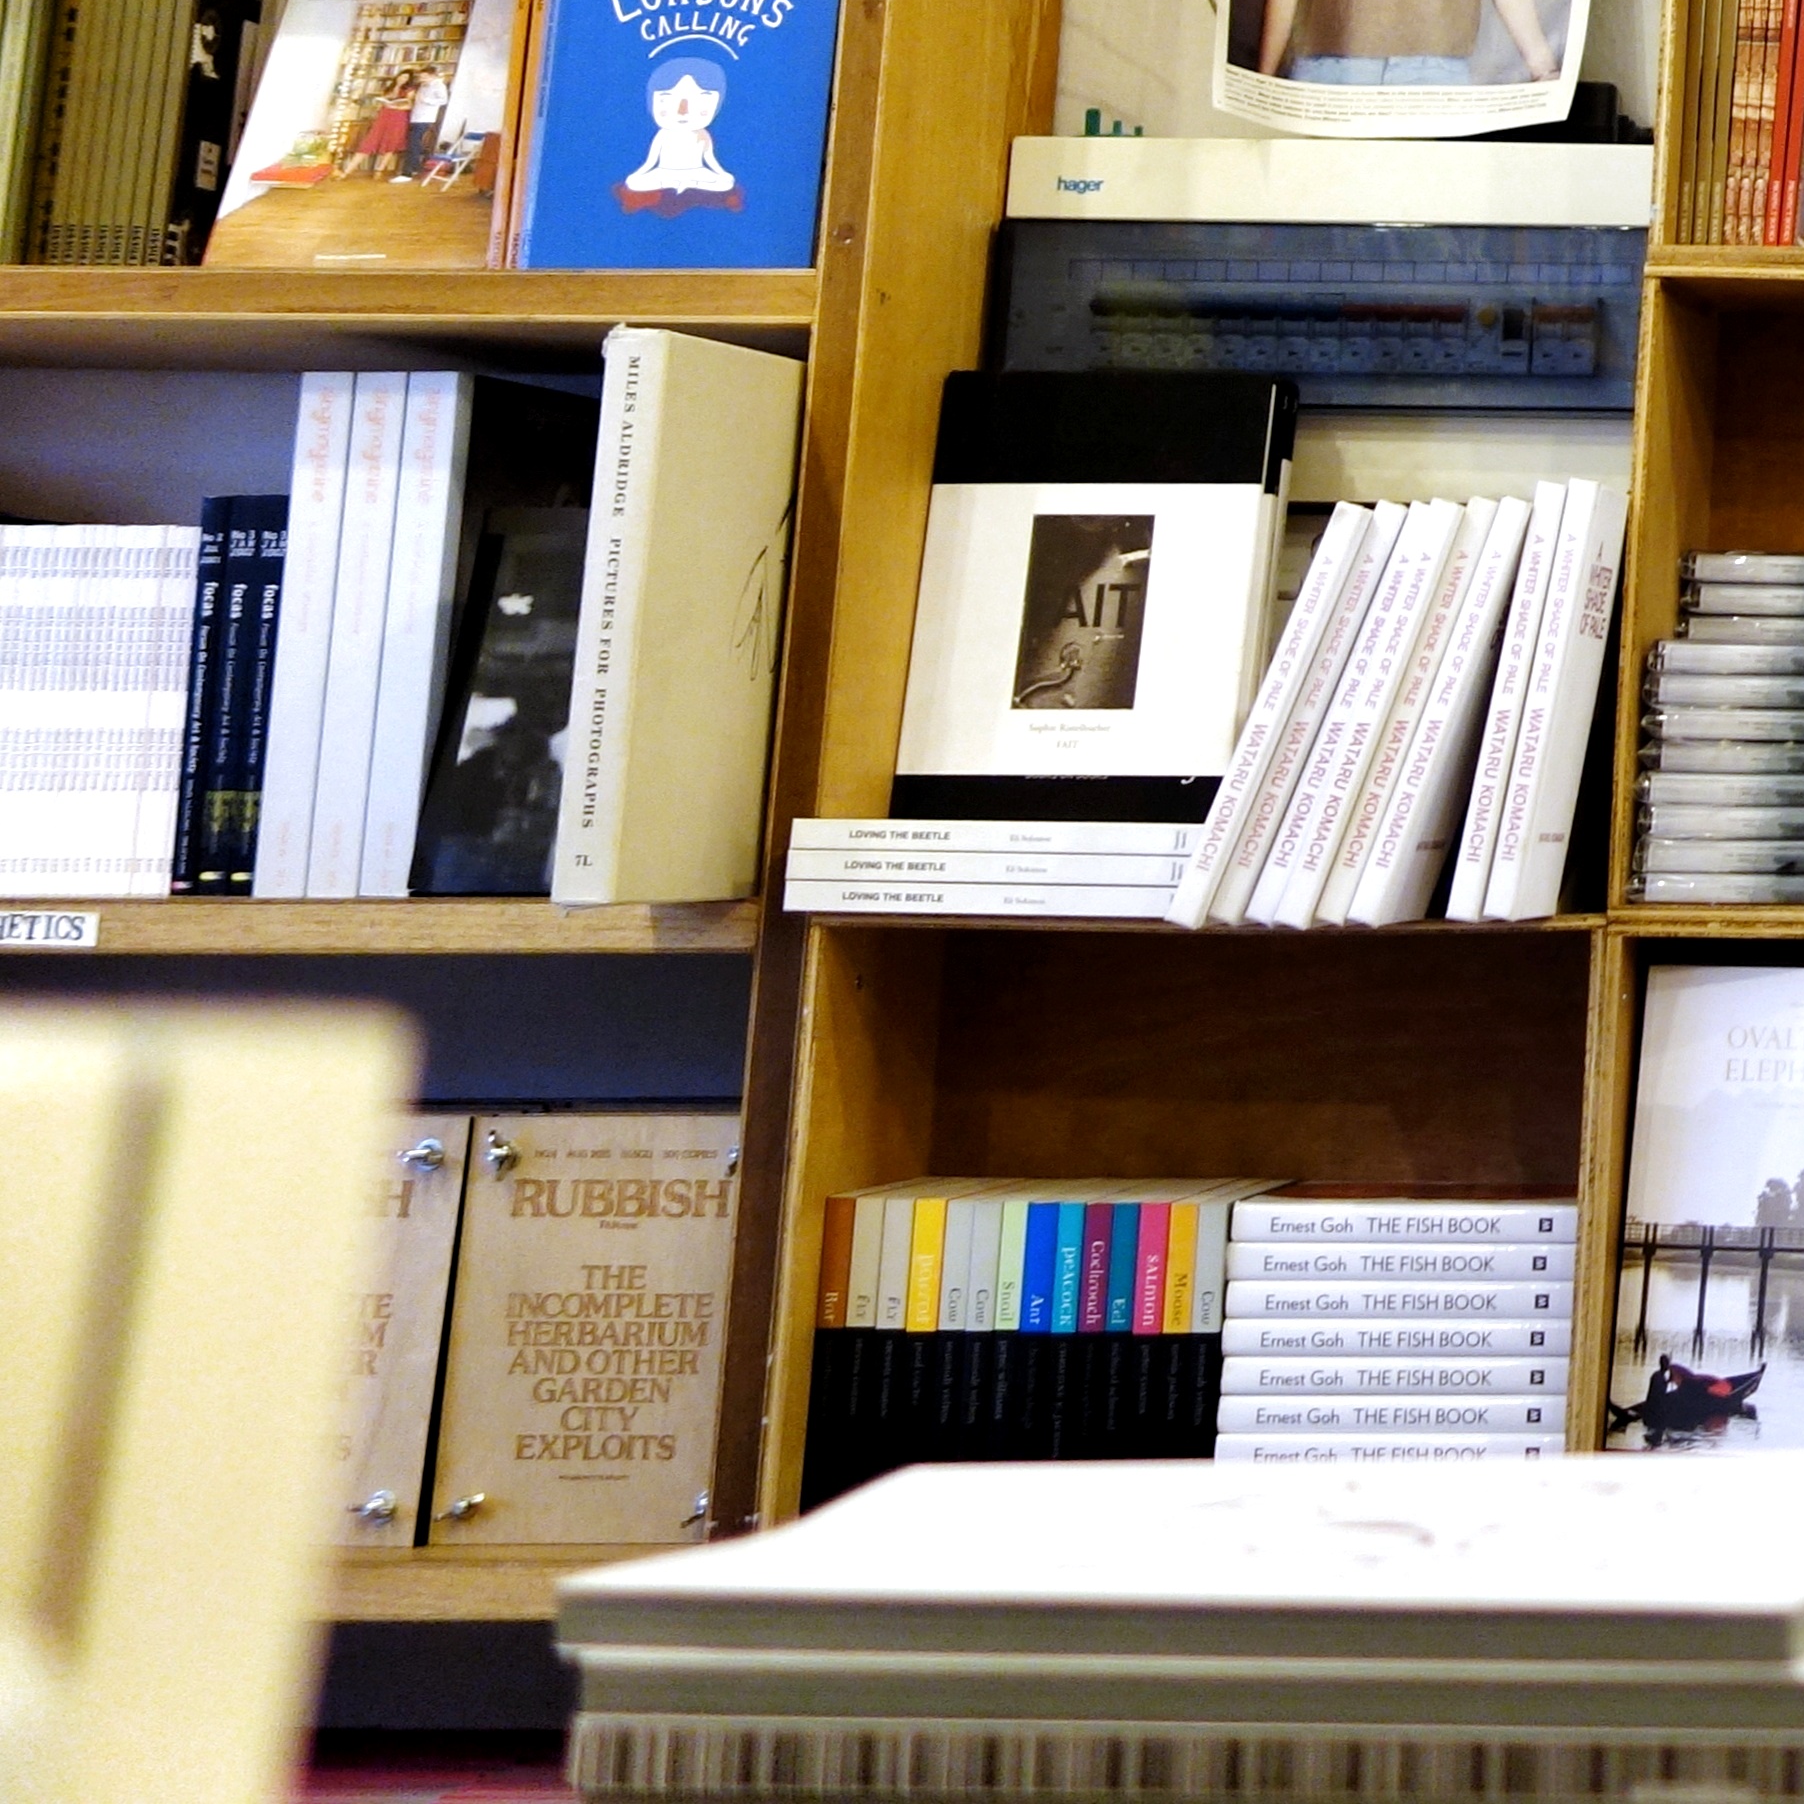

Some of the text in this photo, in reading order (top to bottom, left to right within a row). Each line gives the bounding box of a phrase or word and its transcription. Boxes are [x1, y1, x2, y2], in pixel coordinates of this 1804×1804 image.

[641, 15, 757, 47] CALLING
[1057, 175, 1103, 194] hager
[580, 354, 641, 829] MILES ALDRIDGE PICTURES FOR PHOTOGRAPHS
[1467, 709, 1510, 862] WATARU KOMACHI
[849, 830, 950, 840] LOVING THE BEETLE
[510, 1177, 732, 1218] RUBBISH
[1269, 1216, 1501, 1235] Ernest Goh THE FISH BOOK
[581, 1264, 646, 1290] THE
[506, 1293, 713, 1319] INCOMPLETE
[506, 1321, 708, 1347] HERBARIUM
[507, 1350, 700, 1376] AND OTHER
[533, 1377, 671, 1404] GARDEN
[560, 1406, 640, 1433] CITY
[514, 1434, 676, 1461] EXPLOITS
